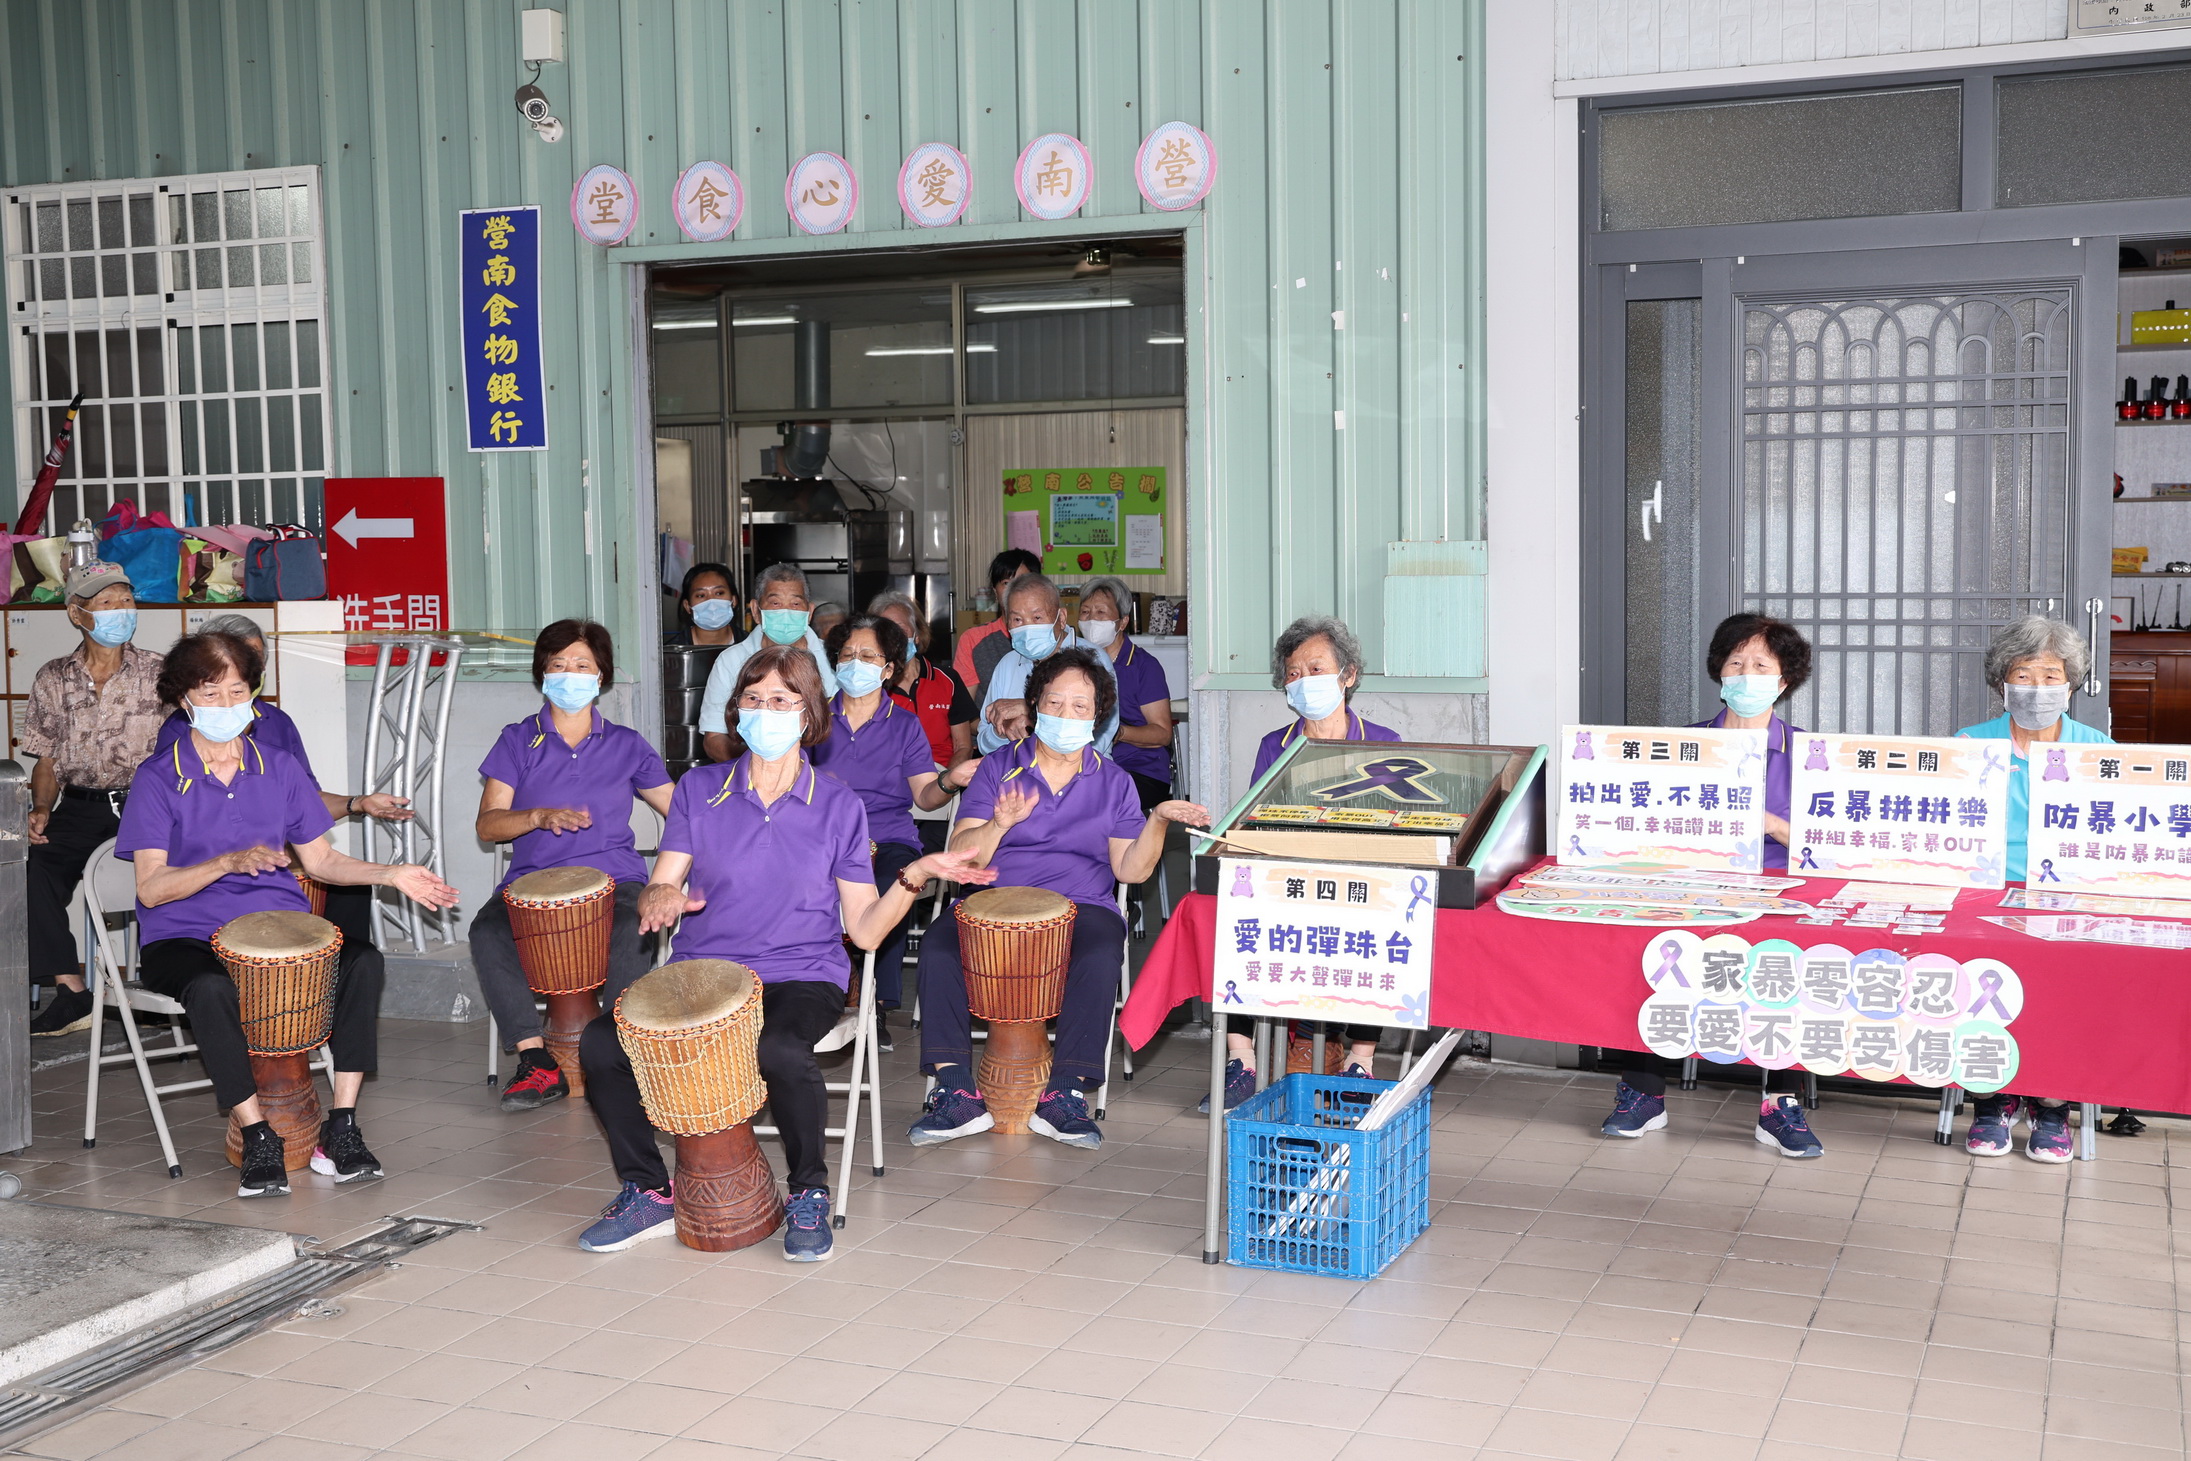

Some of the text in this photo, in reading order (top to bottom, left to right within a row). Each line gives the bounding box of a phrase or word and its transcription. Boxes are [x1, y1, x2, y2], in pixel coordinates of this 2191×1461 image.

[482, 215, 523, 444] 營南食物銀行
[1017, 472, 1156, 494] 營南公告欄
[1622, 740, 1699, 761] 第三關
[1857, 749, 1938, 772] 第二關
[2099, 758, 2187, 781] 第一關
[1807, 789, 1988, 828] 反暴拼拼樂
[1286, 877, 1368, 903] 第四關
[1234, 918, 1413, 964] 愛的彈珠台
[1245, 960, 1395, 991] 愛要大聲彈出來
[1701, 950, 1957, 1014] 家暴零容忍
[1647, 1003, 2007, 1080] 要愛不要受傷害
